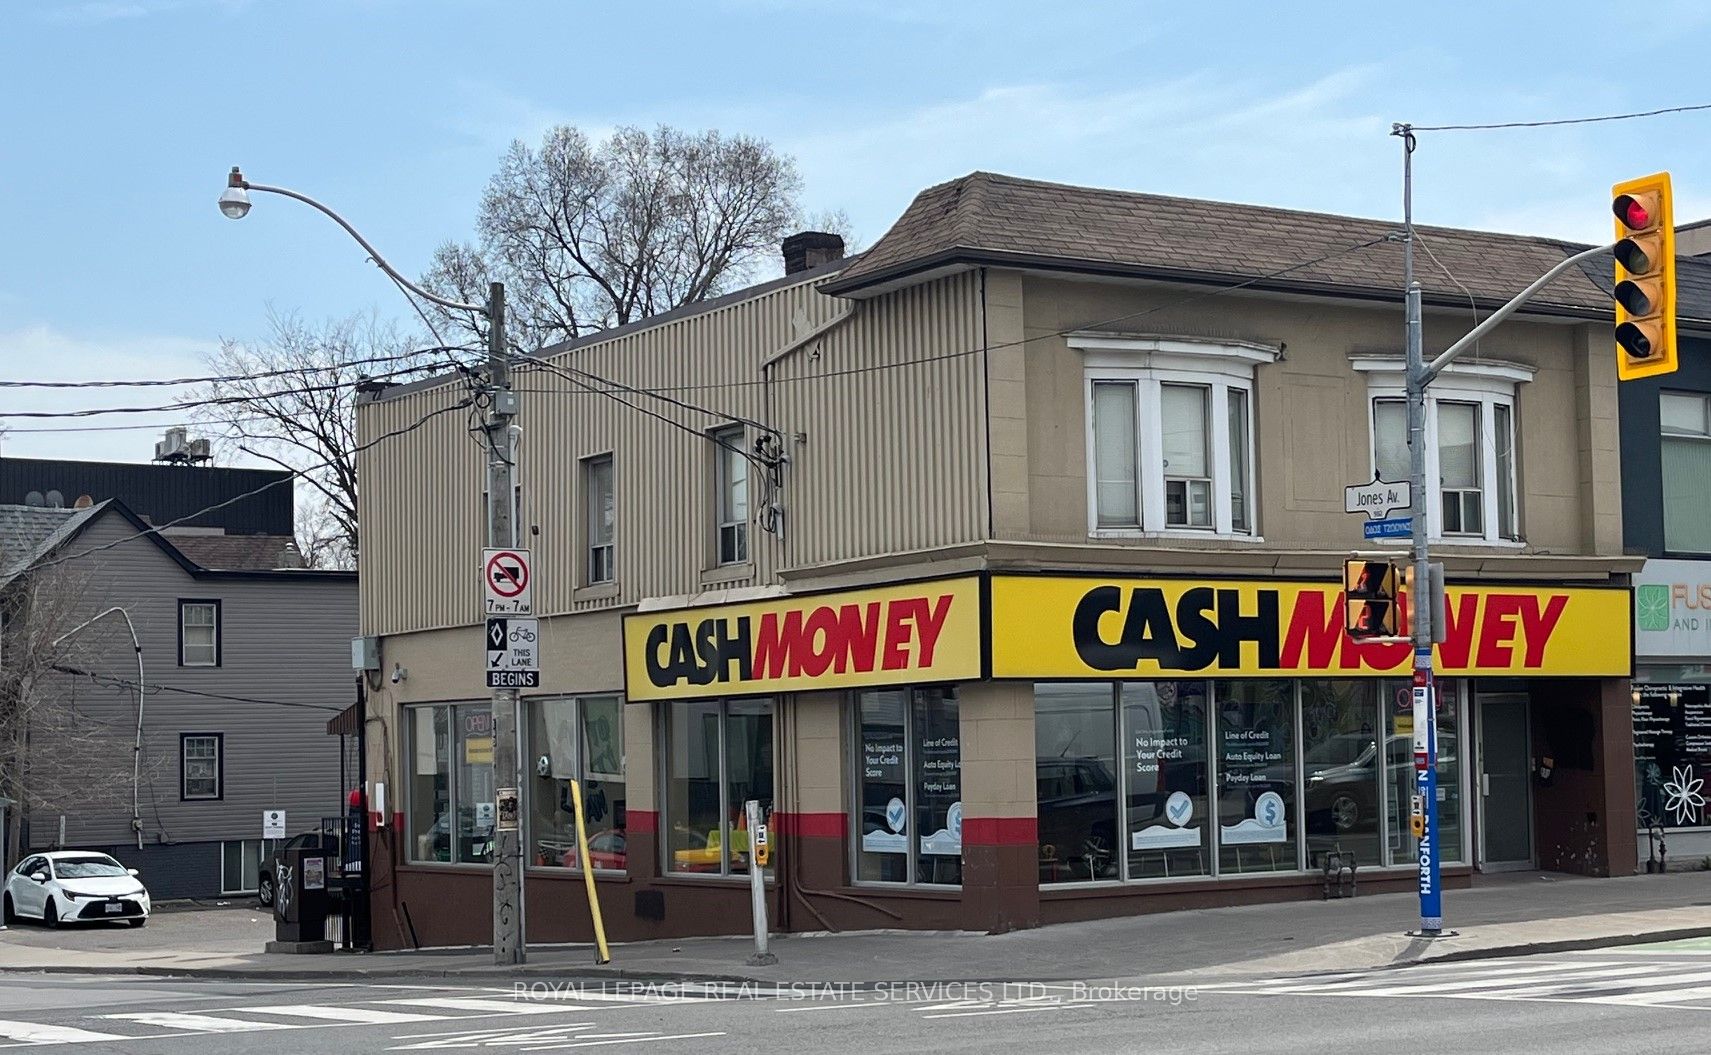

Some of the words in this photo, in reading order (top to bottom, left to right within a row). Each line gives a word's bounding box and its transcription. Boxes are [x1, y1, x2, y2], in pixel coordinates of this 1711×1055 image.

[1356, 492, 1383, 506] Jones
[1386, 489, 1400, 503] Av.
[1673, 618, 1699, 631] AND
[513, 649, 531, 657] THIS
[511, 657, 532, 667] LANE
[492, 672, 534, 686] BEGINS
[1225, 731, 1239, 740] Line
[1240, 731, 1248, 739] of
[1248, 730, 1269, 739] Credit
[923, 739, 934, 747] Line
[935, 739, 941, 747] of
[941, 738, 958, 746] Credit
[1136, 737, 1149, 747] No
[1150, 737, 1178, 749] Impact
[1179, 738, 1188, 746] to
[865, 743, 874, 752] No
[875, 743, 895, 754] Impact
[896, 744, 903, 752] to
[1136, 750, 1156, 760] Your
[1156, 749, 1182, 759] Credit
[1226, 752, 1242, 760] Auto
[1243, 751, 1265, 762] Equity
[1265, 751, 1281, 760] Loan
[865, 756, 879, 765] Your
[879, 755, 899, 764] Credit
[865, 767, 882, 777] Score
[1136, 762, 1160, 772] Score
[1226, 773, 1249, 783] Payday
[1250, 773, 1267, 781] Loan
[923, 782, 942, 792] Payday
[942, 782, 956, 790] Loan
